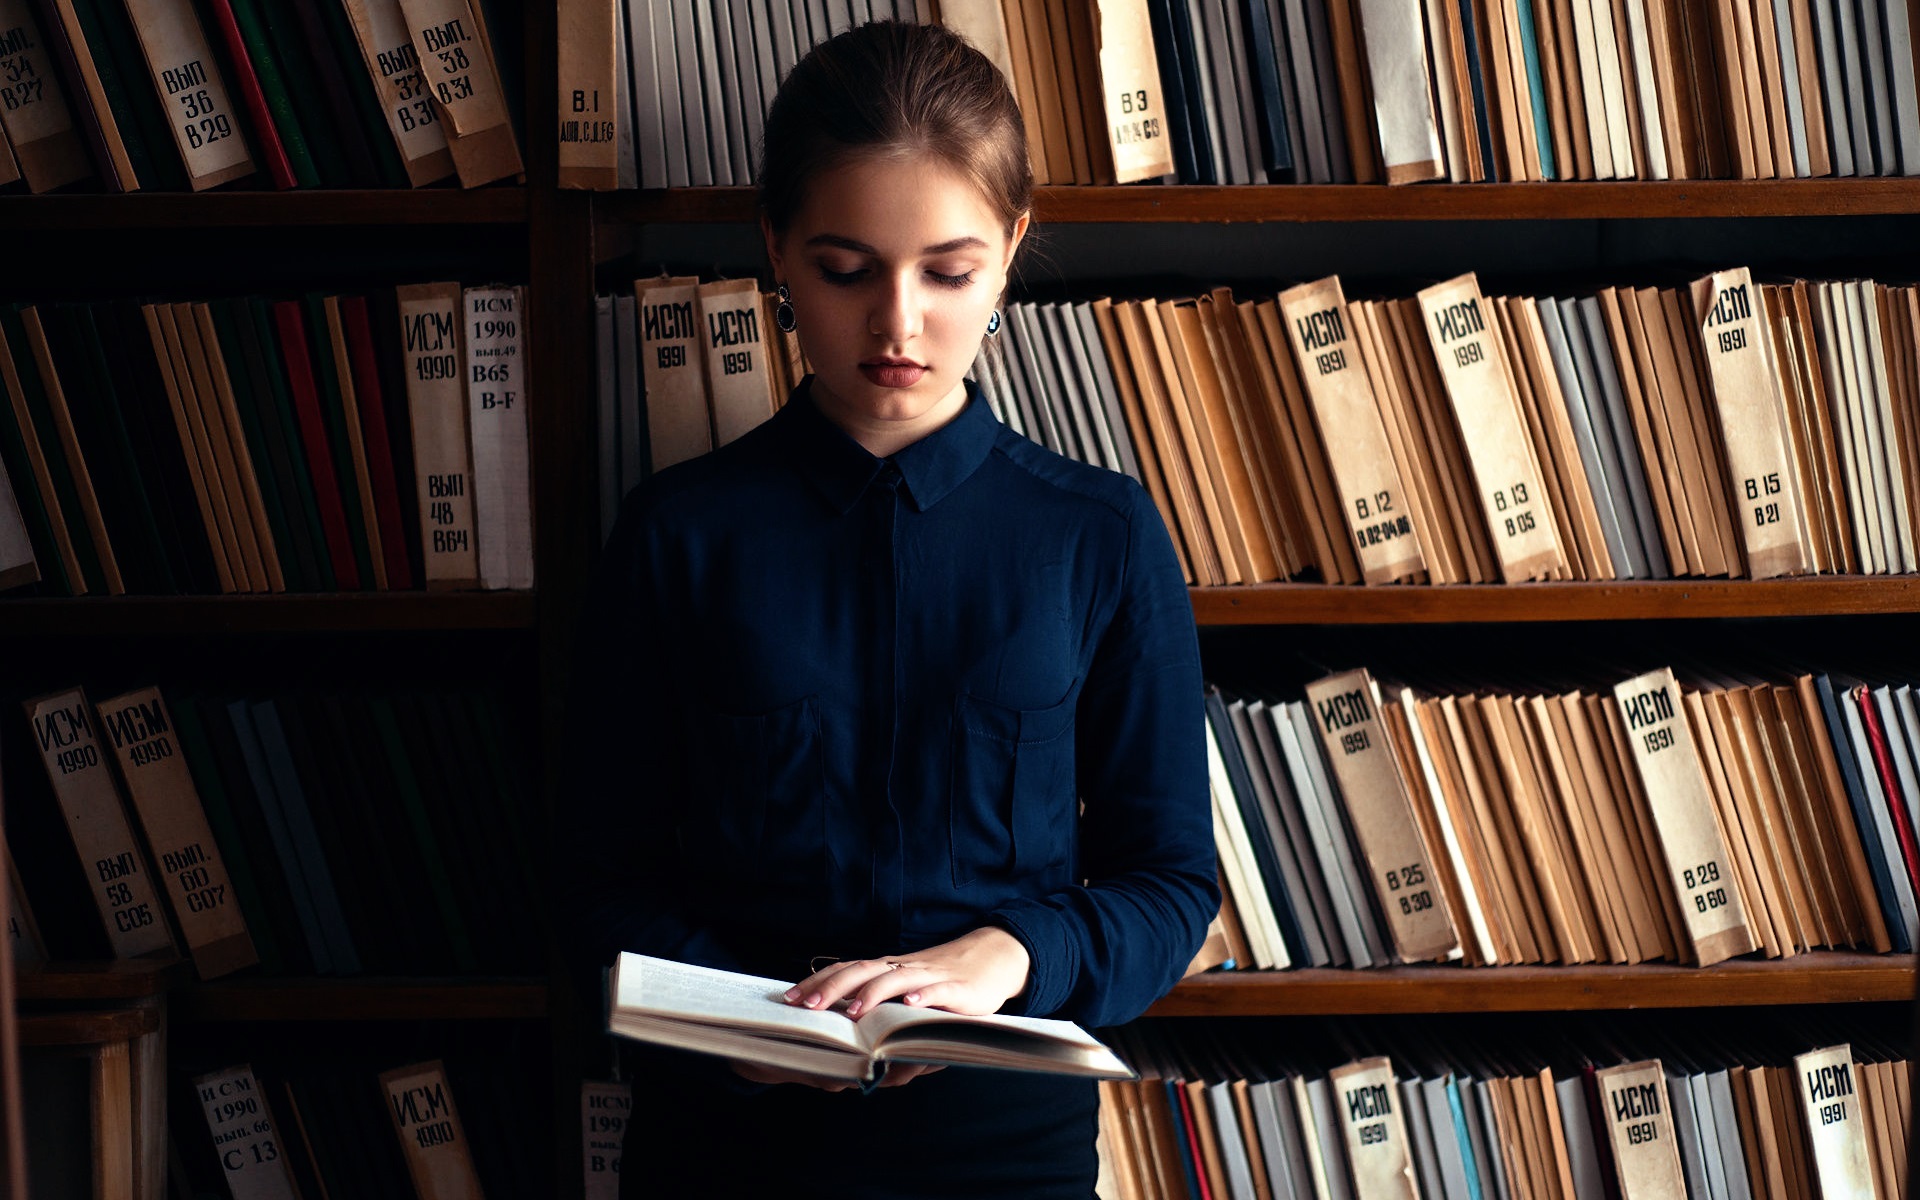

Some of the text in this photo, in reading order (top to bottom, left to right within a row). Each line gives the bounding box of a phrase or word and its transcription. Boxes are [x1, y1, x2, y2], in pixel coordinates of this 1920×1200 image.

[0, 28, 34, 57] ЫП.
[1, 56, 34, 81] 34
[438, 47, 470, 73] 38
[162, 60, 207, 94] ВЫП
[395, 70, 422, 100] 37
[181, 89, 214, 118] 36
[474, 298, 513, 313] ИСМ
[404, 311, 455, 352] ИСМ
[474, 321, 516, 339] 1990
[643, 302, 695, 341] ИСМ
[708, 308, 759, 348] ИСМ
[1296, 306, 1347, 352] ИСМ
[1434, 297, 1485, 343] ИСМ
[1718, 328, 1747, 354] 1991
[416, 354, 456, 381] 1990
[657, 345, 686, 369] 1991
[722, 351, 752, 375] 1991
[1316, 349, 1347, 376] 1991
[1453, 342, 1485, 368] 1991
[428, 474, 464, 498] ВЫП
[431, 502, 454, 526] 48
[1317, 688, 1371, 734] ИСМ
[1624, 684, 1675, 730] ИСМ
[35, 704, 92, 752] ИСМ
[106, 699, 168, 748] ИСМ
[130, 737, 173, 768] 1990
[1340, 729, 1371, 756] 1991
[1643, 726, 1675, 754] 1991
[57, 744, 98, 774] 1990
[96, 852, 137, 882] ВЫП
[180, 867, 209, 892] 60
[106, 882, 133, 907] 58
[1807, 1063, 1853, 1104] ИСМ
[214, 1097, 258, 1123] 1990
[392, 1083, 449, 1127] ИСМ
[1346, 1083, 1392, 1122] ИСМ
[1612, 1082, 1661, 1122] ИСМ
[1819, 1101, 1847, 1126] 1991
[253, 1120, 271, 1133] 66
[416, 1121, 454, 1148] 1990
[590, 1116, 622, 1132] 199
[1359, 1122, 1388, 1146] 1991
[1627, 1121, 1658, 1145] 1991
[250, 1140, 277, 1163] 13
